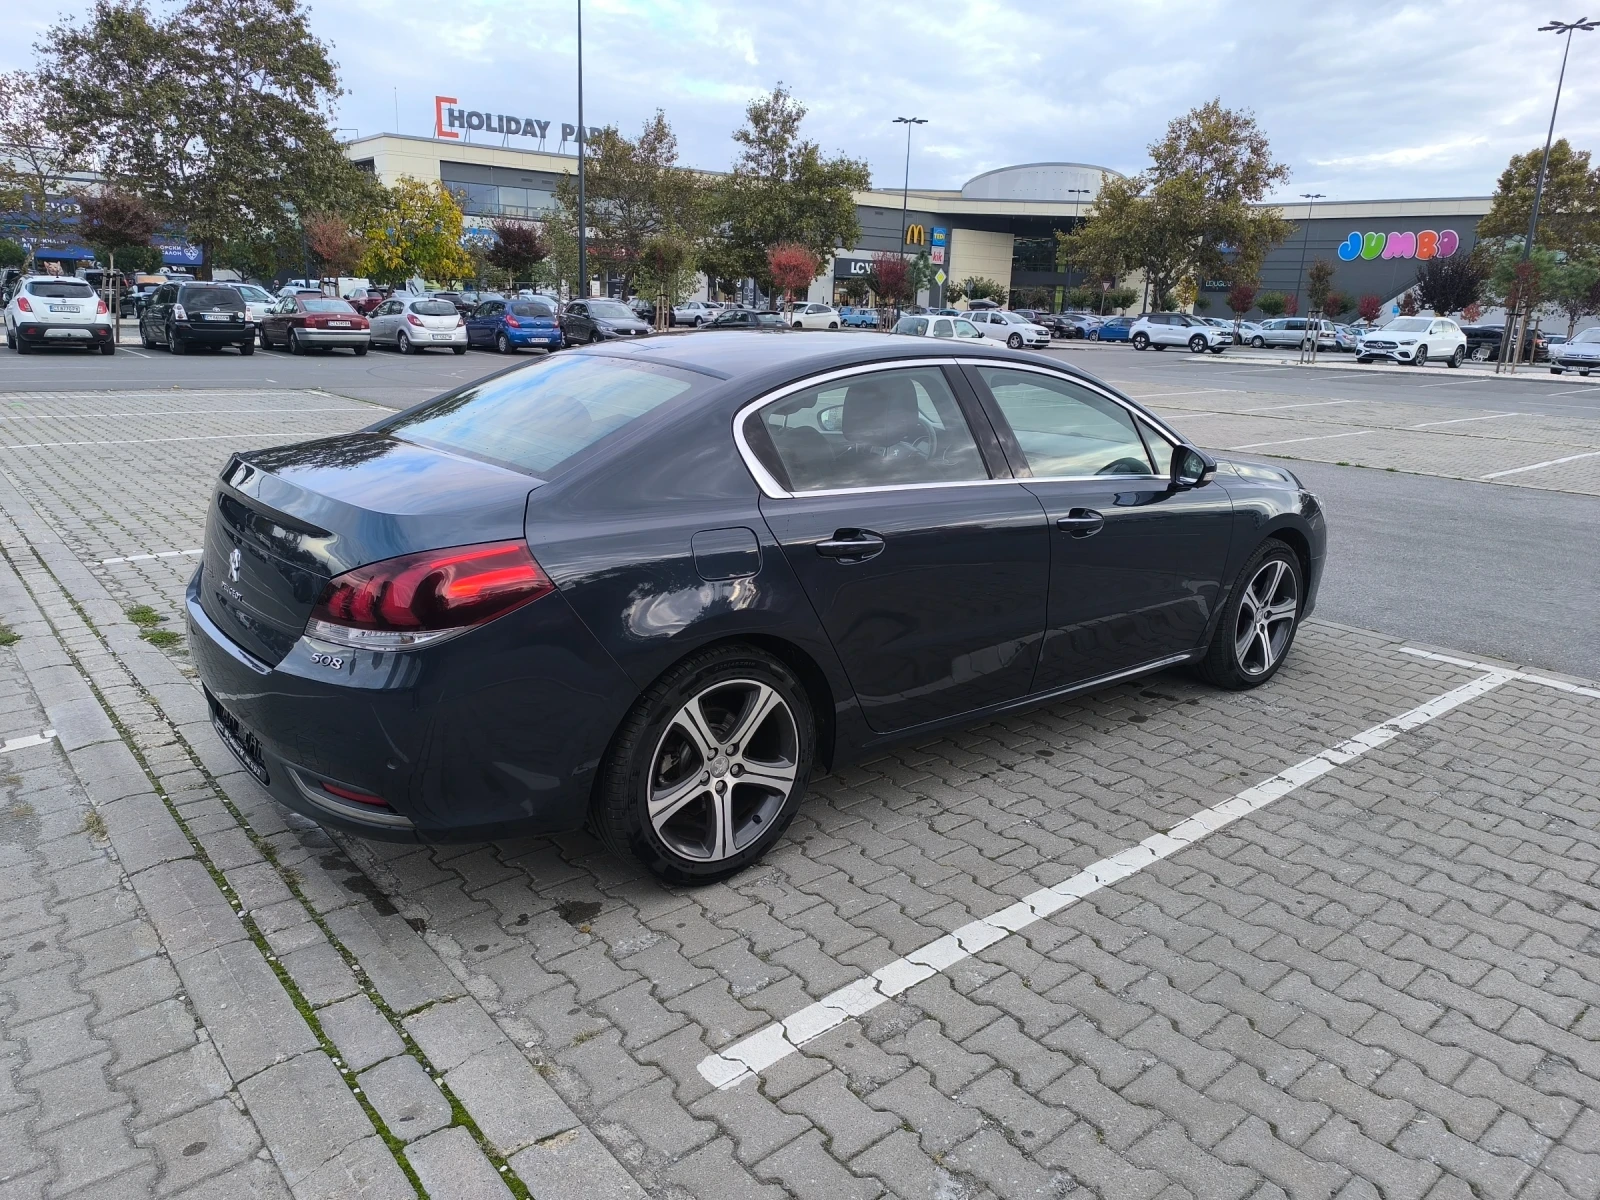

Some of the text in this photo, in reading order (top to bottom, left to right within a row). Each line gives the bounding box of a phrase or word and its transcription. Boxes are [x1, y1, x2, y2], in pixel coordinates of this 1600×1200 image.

[447, 107, 603, 142] HOLIDAY PAR
[1337, 228, 1460, 262] JUMBO
[310, 652, 344, 670] 508
